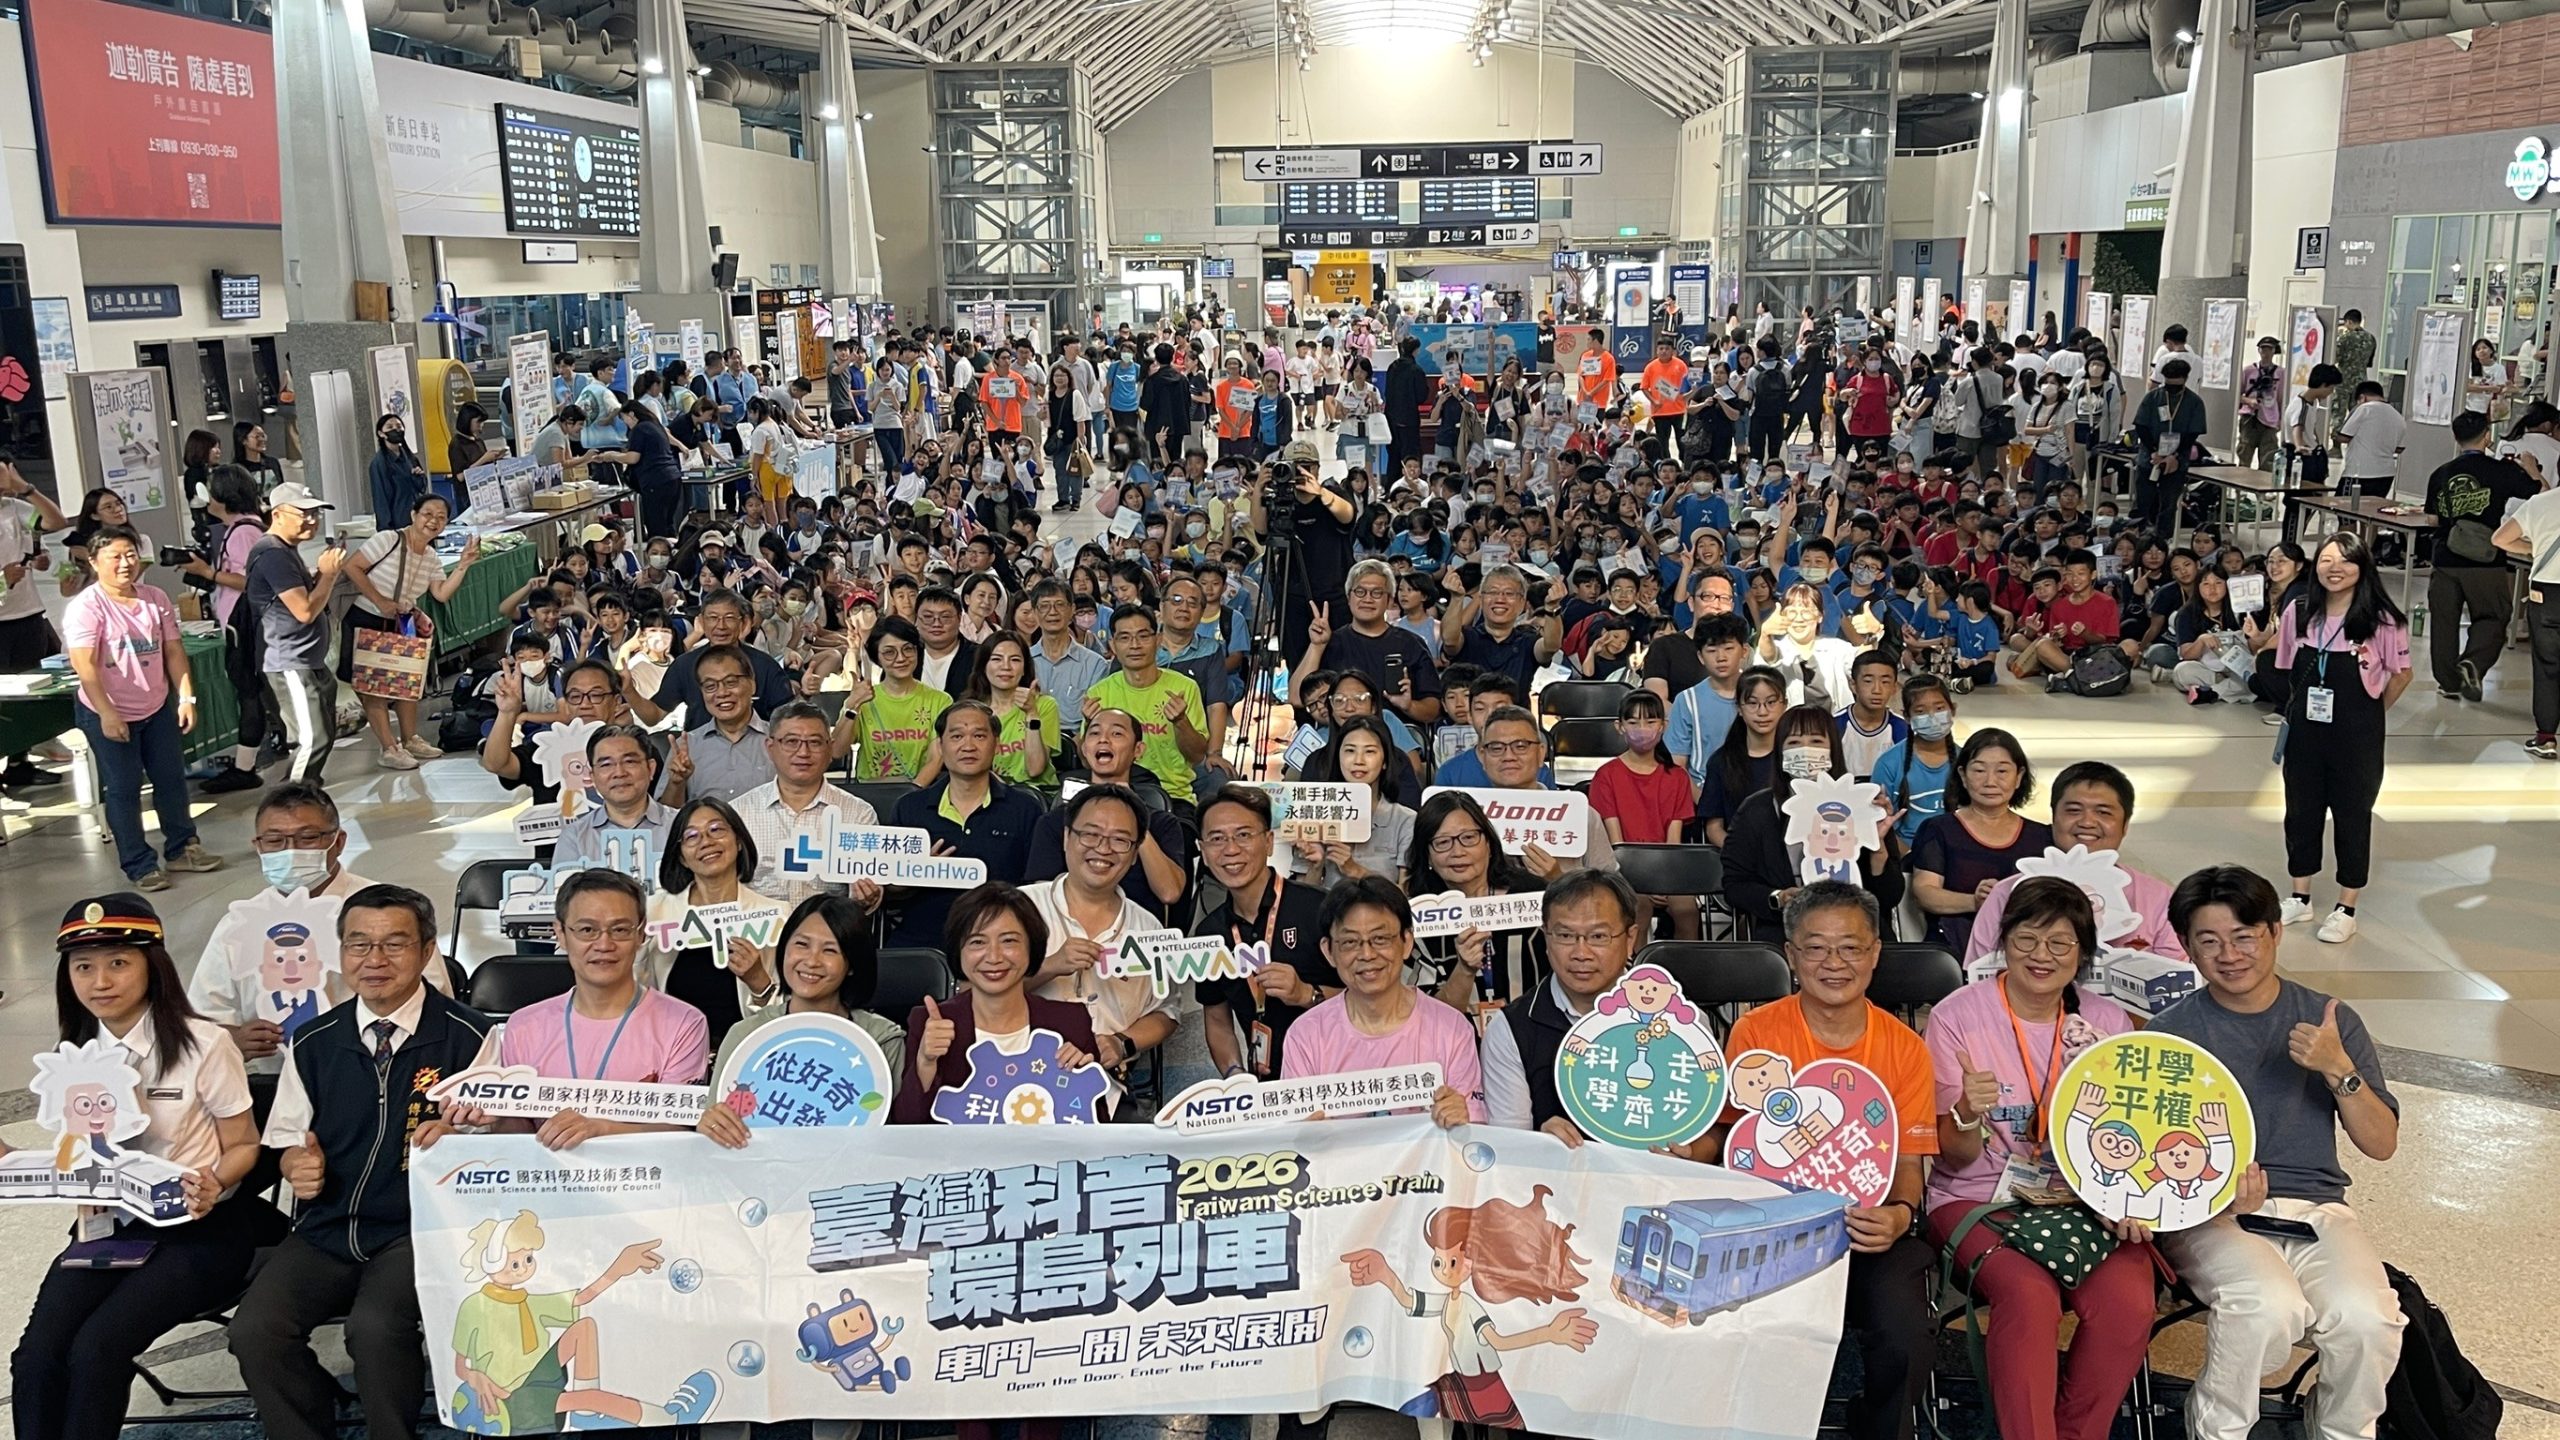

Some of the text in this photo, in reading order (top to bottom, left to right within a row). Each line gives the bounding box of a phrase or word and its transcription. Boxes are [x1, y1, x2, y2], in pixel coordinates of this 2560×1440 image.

[105, 42, 254, 99] 迦勒廣告 隨處看到
[386, 114, 441, 144] 新烏日車站
[180, 140, 238, 158] 0930-030-950
[416, 147, 441, 160] STATION
[1302, 233, 1308, 244] 1
[1310, 233, 1324, 241] 月台
[1442, 231, 1450, 242] 2
[872, 728, 929, 743] SPARK
[1292, 787, 1352, 802] 攜手擴大
[1285, 805, 1359, 821] 永續影響力
[838, 831, 923, 855] 聯華林德
[1502, 827, 1578, 846] 華邦電子
[837, 857, 979, 882] Linde LienHwa
[1411, 923, 1449, 934] ational
[1495, 916, 1513, 924] and
[2113, 1044, 2194, 1087] 科學
[765, 1050, 861, 1113] 從好奇
[458, 1082, 710, 1109] NSTC 國家科學及技術委員會
[1185, 1072, 1436, 1118] NSTC 國家科學及技術委員會
[2111, 1084, 2193, 1129] 平權
[515, 1101, 561, 1112] Science
[594, 1106, 660, 1120] Technology
[1186, 1089, 1436, 1129] National Science and Technology Council
[456, 1166, 662, 1184] NSTC 國家科學及技術委員會
[1177, 1150, 1300, 1195] 2026
[455, 1183, 661, 1195] National Science and Technology Council
[1178, 1170, 1441, 1220] Taiwan Science Train
[927, 1213, 1294, 1323] 環島列車
[934, 1304, 1330, 1382] 車門一開 未來展開
[1006, 1380, 1046, 1391] Open
[1053, 1375, 1078, 1385] the
[1130, 1366, 1173, 1377] Enter
[1179, 1361, 1204, 1371] the
[1210, 1356, 1263, 1368] Future
